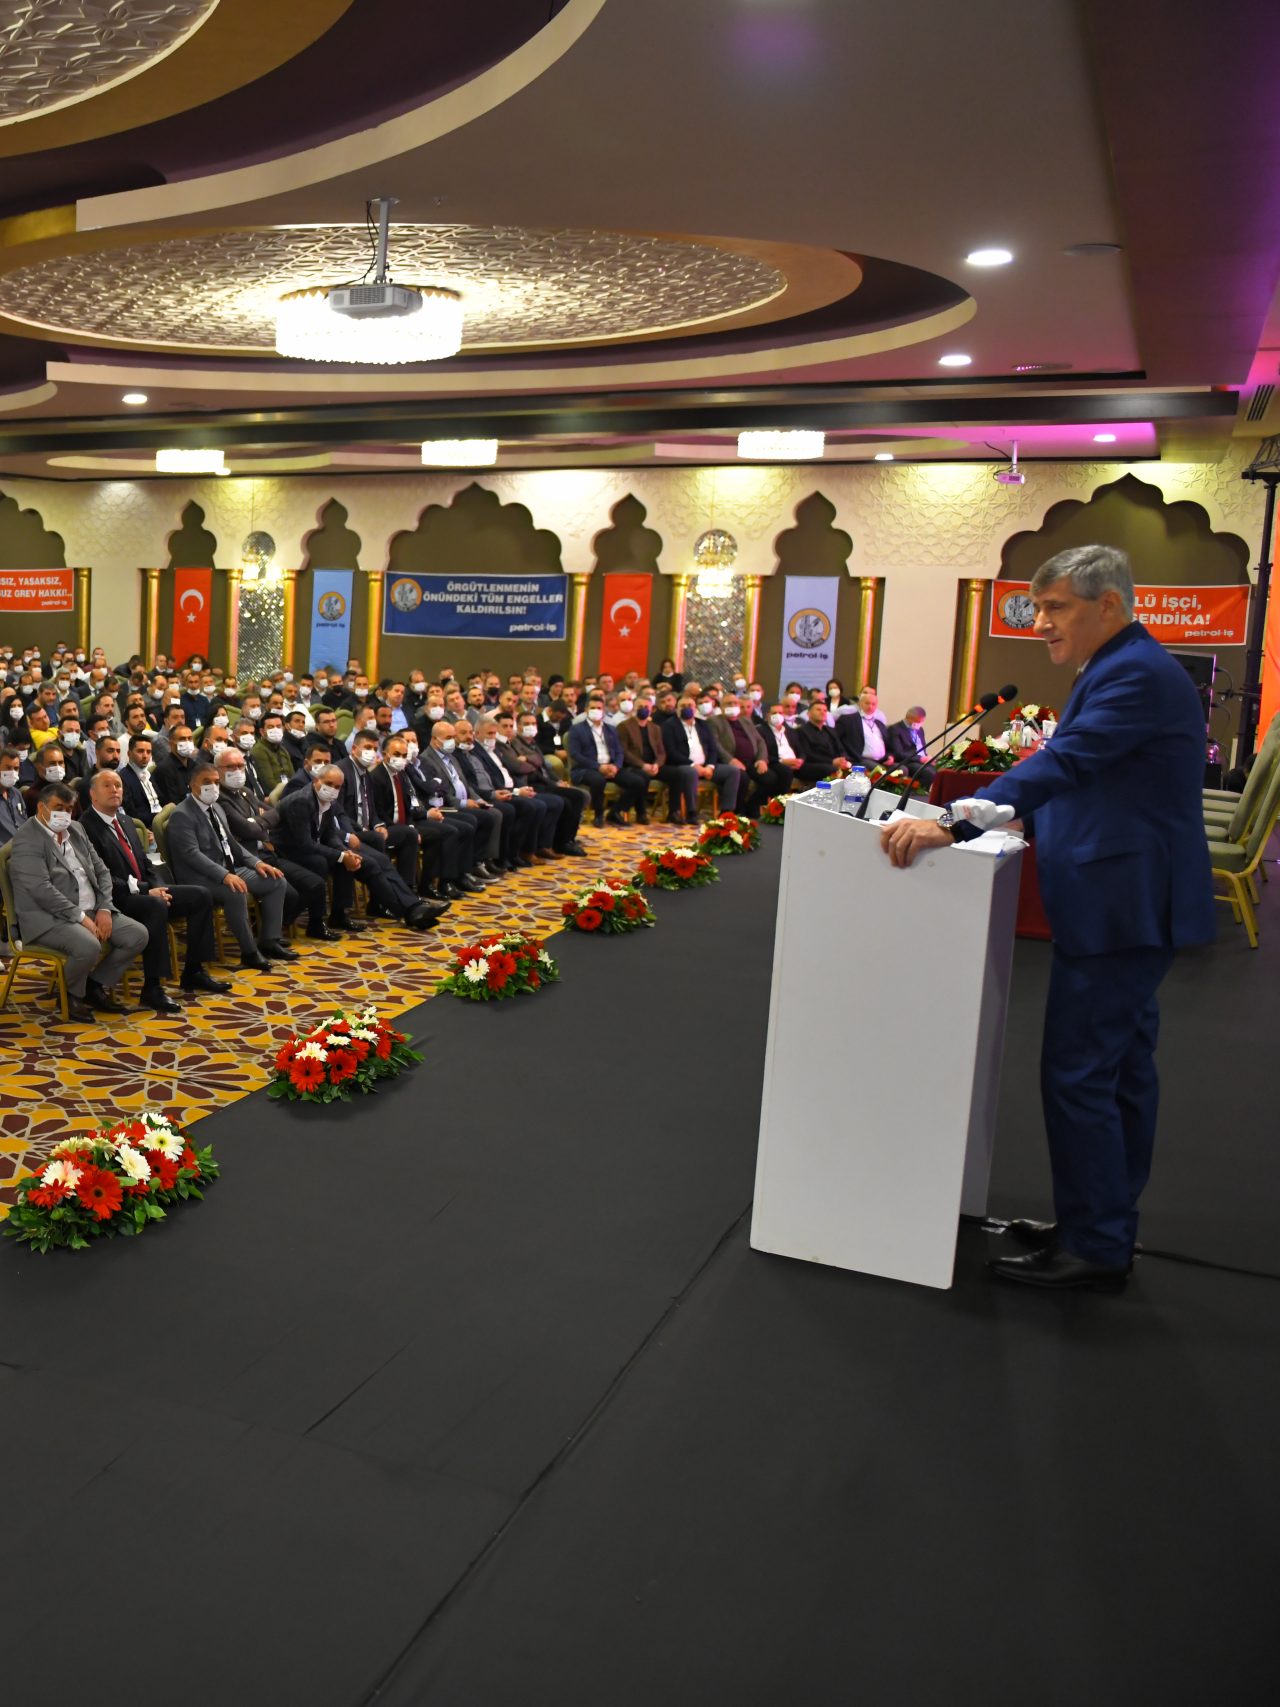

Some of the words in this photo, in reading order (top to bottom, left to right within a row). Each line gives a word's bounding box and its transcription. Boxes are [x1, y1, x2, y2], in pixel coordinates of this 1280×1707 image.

[18, 576, 62, 586] YASAKSIZ,
[446, 581, 539, 592] ÖRGÜTLENMENİN
[14, 589, 37, 598] GREV
[423, 591, 478, 602] ÖNÜNDEKİ
[480, 593, 504, 603] TÜM
[506, 594, 563, 603] ENGELLER
[1162, 594, 1202, 611] İŞÇİ,
[456, 605, 527, 615] KALDIRILSIN!
